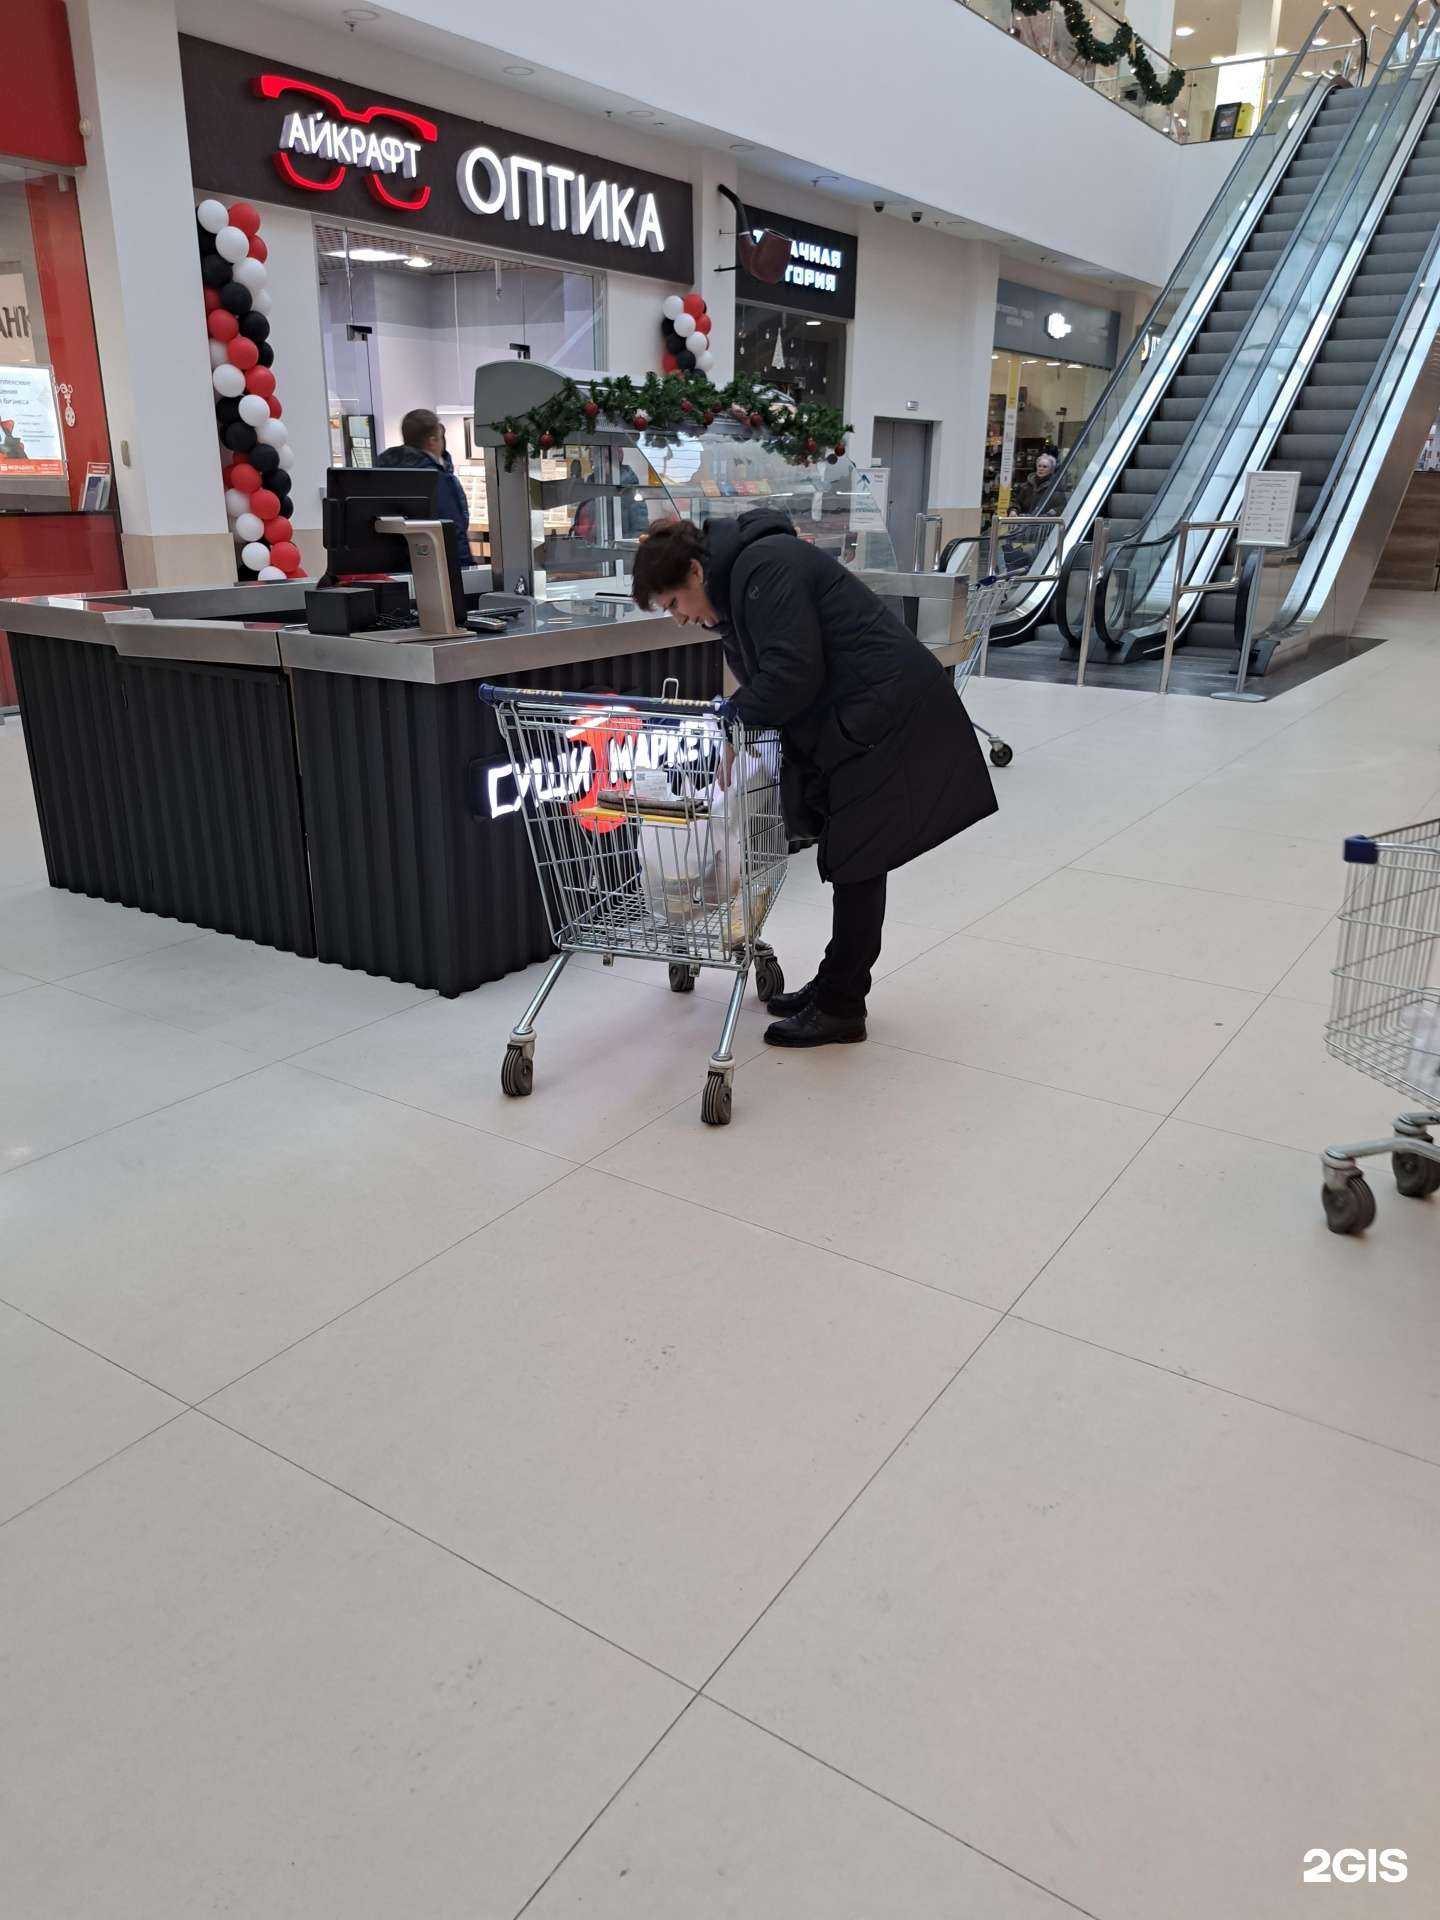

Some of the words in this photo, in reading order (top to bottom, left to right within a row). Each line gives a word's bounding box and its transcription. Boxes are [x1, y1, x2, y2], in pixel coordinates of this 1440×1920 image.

[280, 112, 421, 178] АЙКРАФТ
[457, 146, 664, 253] ОПТИКА
[752, 229, 842, 269] ТАЧНАЯ
[784, 264, 837, 292] ТОРИЯ
[487, 746, 592, 819] СУШИ
